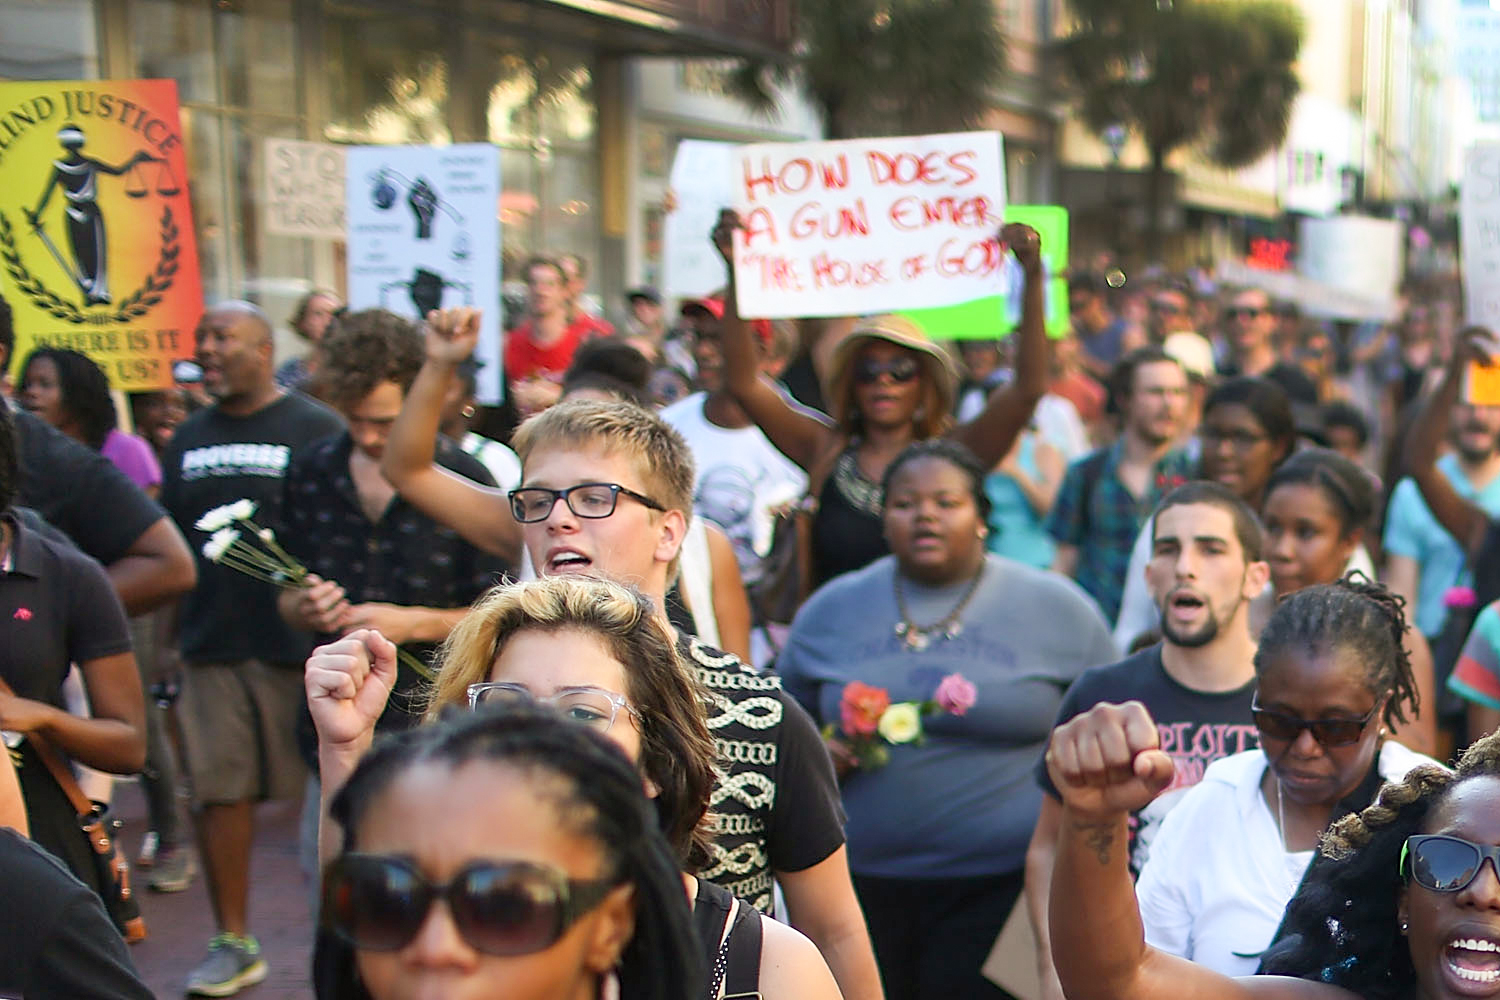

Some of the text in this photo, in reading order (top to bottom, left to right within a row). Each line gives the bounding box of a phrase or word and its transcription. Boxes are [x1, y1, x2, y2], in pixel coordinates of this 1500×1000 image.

[61, 91, 180, 155] JUSTICE
[743, 150, 978, 201] HOW DOES
[742, 195, 1002, 247] A GUN ENTER
[127, 330, 149, 350] IS
[156, 329, 179, 349] IT
